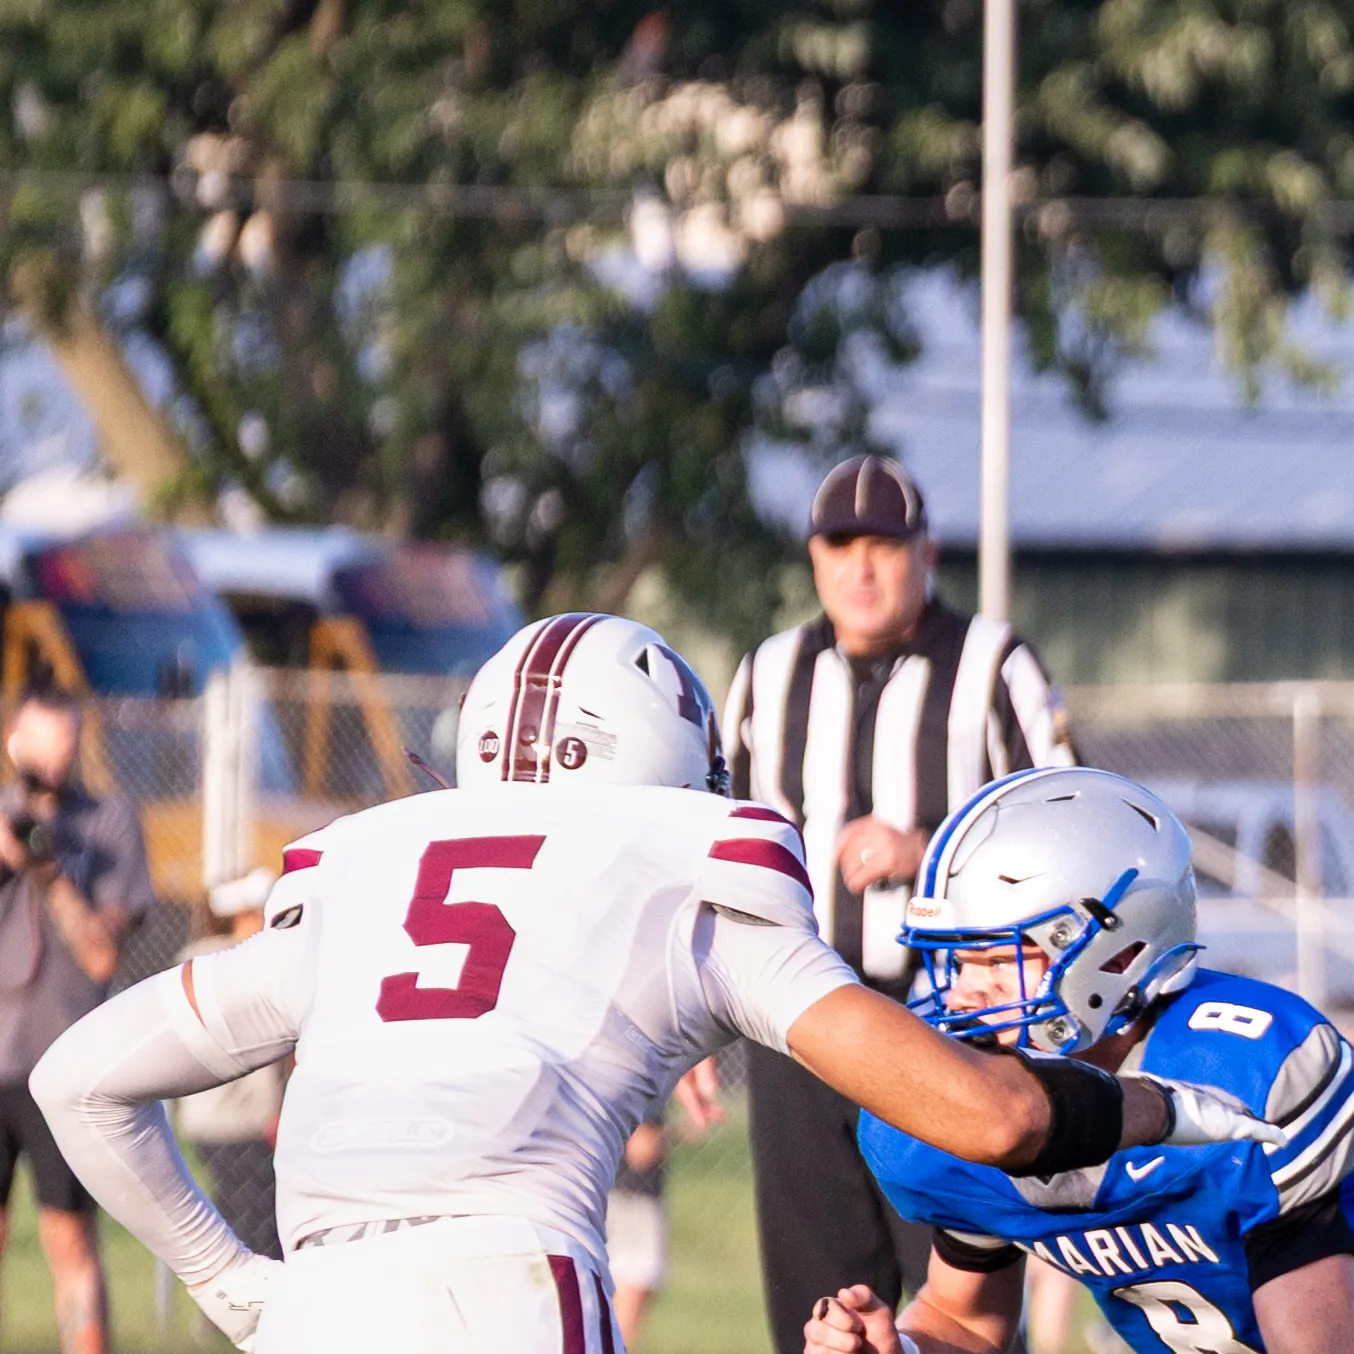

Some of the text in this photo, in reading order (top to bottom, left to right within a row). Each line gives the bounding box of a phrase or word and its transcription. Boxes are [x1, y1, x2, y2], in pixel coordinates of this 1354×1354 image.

[563, 740, 578, 767] 5
[376, 835, 546, 1021] 5
[1188, 1001, 1274, 1040] 8
